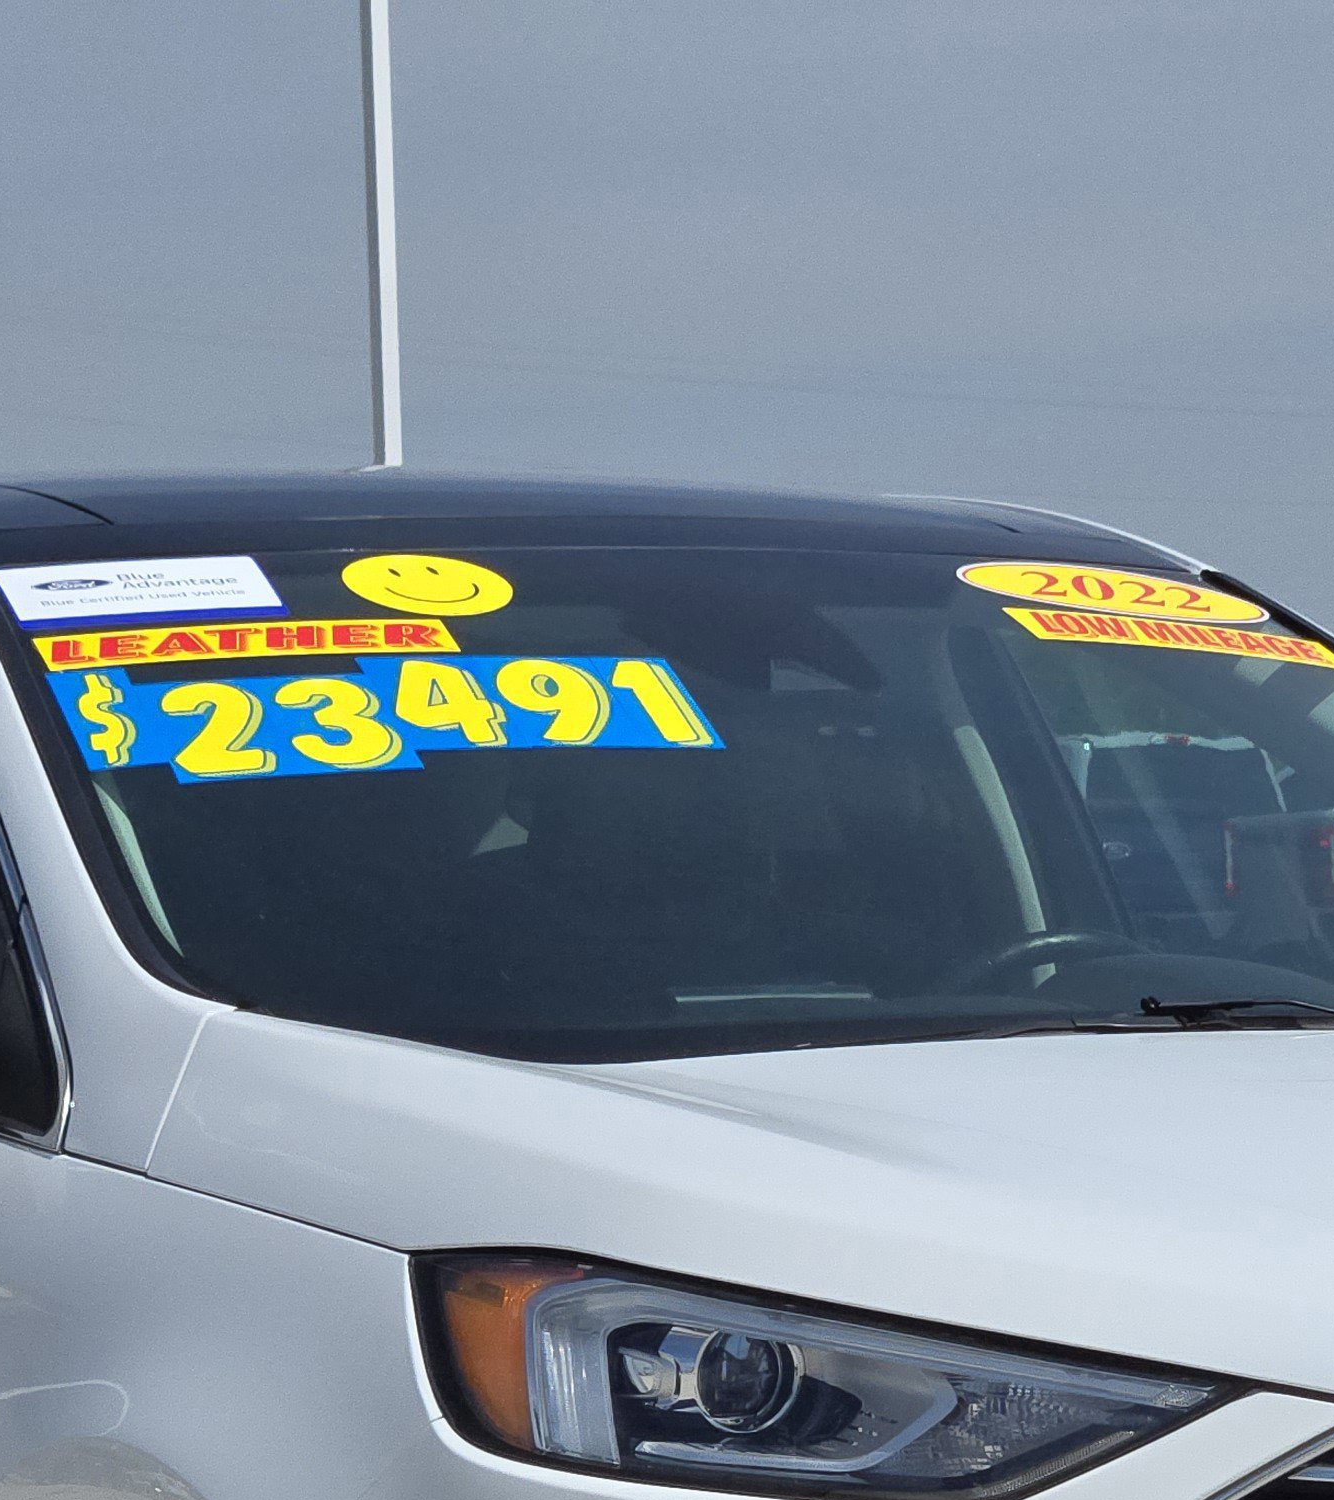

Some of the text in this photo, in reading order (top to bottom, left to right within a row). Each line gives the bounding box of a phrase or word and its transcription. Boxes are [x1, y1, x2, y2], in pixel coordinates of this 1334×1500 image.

[116, 572, 165, 582] Blue
[123, 578, 238, 589] Advantage
[1021, 570, 1211, 612] 2022
[51, 622, 442, 665] LEATHER
[1028, 610, 1330, 663] LOW MILEAGE
